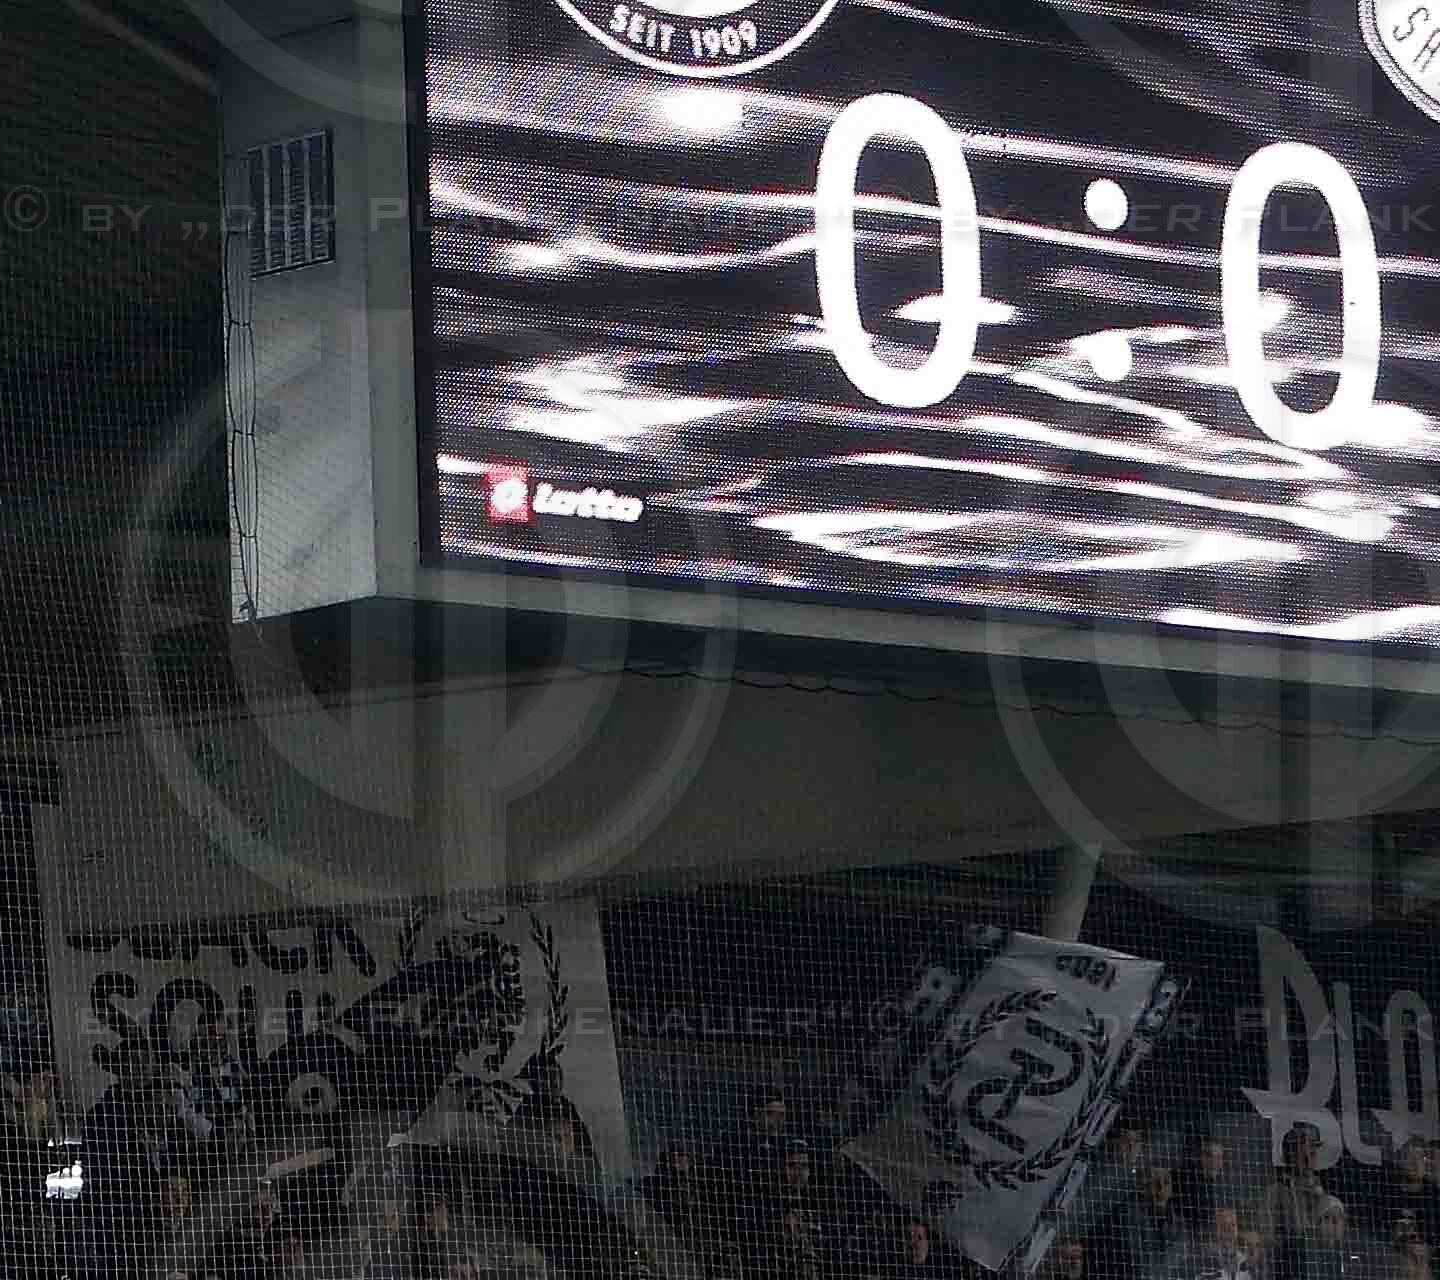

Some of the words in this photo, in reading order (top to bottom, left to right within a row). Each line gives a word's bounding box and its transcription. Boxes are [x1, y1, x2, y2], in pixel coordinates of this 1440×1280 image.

[610, 4, 673, 52] SEIT
[688, 20, 758, 57] 1909
[816, 93, 982, 409] 0
[1221, 140, 1380, 451] 0
